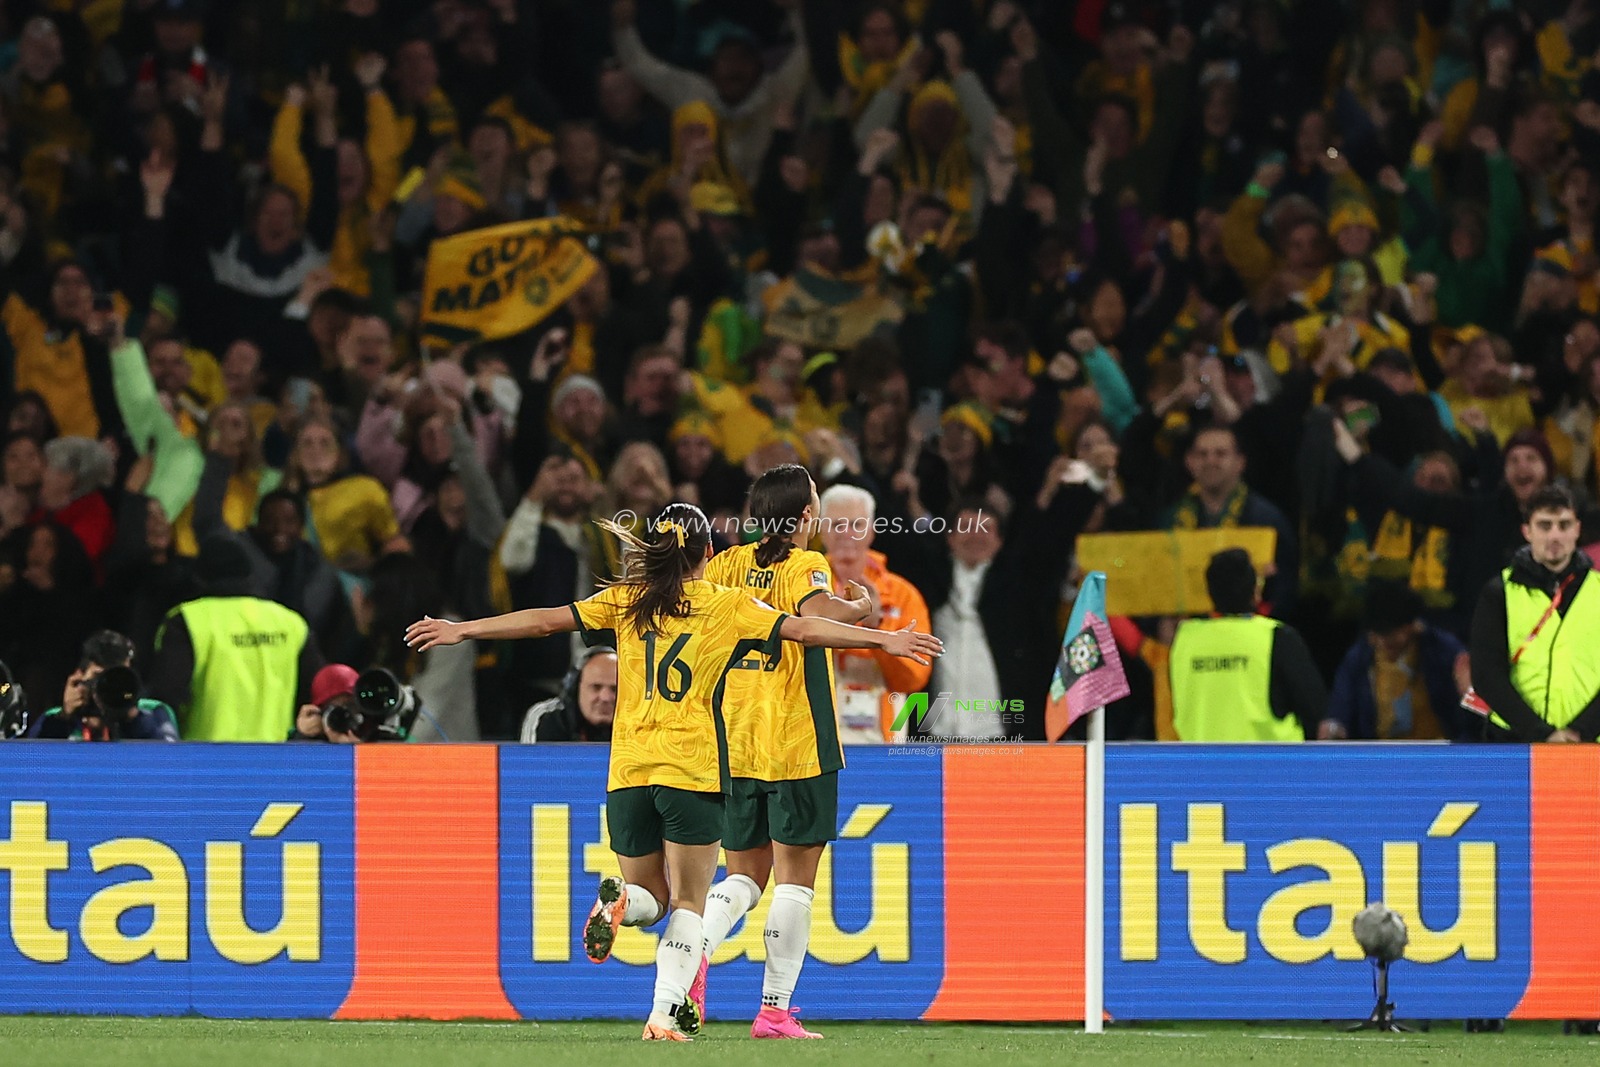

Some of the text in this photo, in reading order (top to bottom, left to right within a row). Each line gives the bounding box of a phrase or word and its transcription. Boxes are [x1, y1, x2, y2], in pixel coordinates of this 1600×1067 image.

[745, 568, 774, 589] ERR
[639, 631, 693, 702] 16
[1119, 802, 1497, 964] Itaú
[708, 893, 731, 904] AUS
[665, 940, 692, 953] AUS
